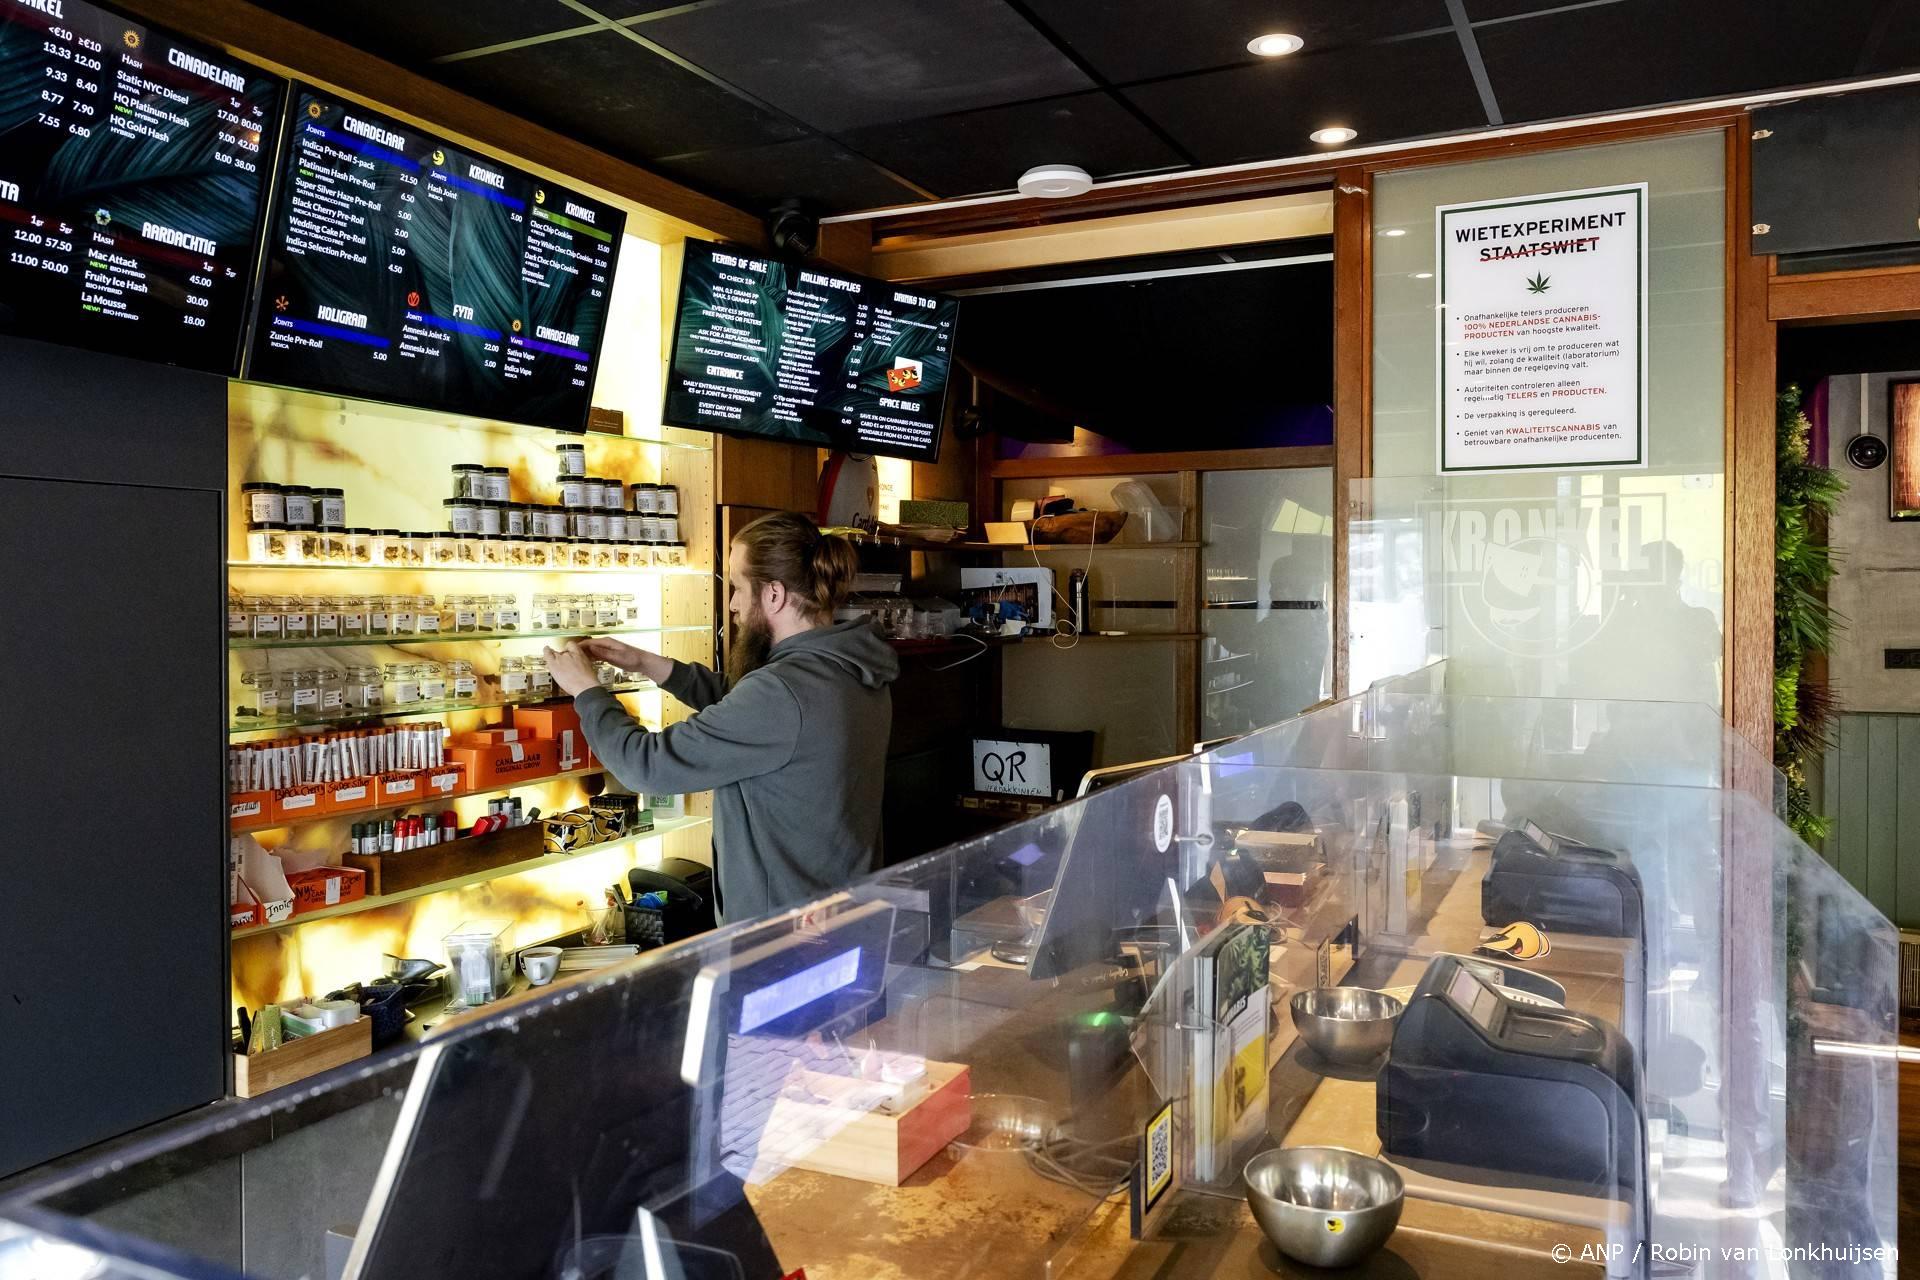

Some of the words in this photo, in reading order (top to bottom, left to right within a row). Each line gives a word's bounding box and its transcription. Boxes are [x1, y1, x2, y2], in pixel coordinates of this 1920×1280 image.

[43, 42, 71, 59] 13.33
[74, 54, 101, 70] 12.00
[46, 67, 67, 82] 9.33
[76, 79, 97, 93] 8.40
[168, 48, 245, 93] CANADELAAR
[42, 90, 64, 104] 8.77
[73, 101, 94, 115] 7.90
[117, 70, 142, 87] Static
[143, 80, 162, 94] NYC
[163, 88, 189, 105] Diesel
[217, 109, 239, 125] 17.00
[241, 118, 262, 133] 80.00
[38, 113, 60, 128] 7.55
[69, 124, 90, 138] 6.80
[113, 92, 129, 104] HQ
[130, 99, 168, 119] Platinum
[169, 114, 189, 128] Hash
[218, 131, 235, 145] 9.00
[238, 139, 259, 153] 42.00
[343, 115, 405, 152] CANADELAAR
[110, 115, 126, 127] HQ
[127, 120, 147, 134] Gold
[148, 128, 170, 143] Hash
[215, 152, 232, 165] 8.00
[234, 158, 256, 173] 38.00
[302, 138, 324, 153] Indica
[324, 146, 352, 162] Pre-Roll
[353, 156, 375, 171] 5-pack
[400, 173, 418, 186] 21.50
[299, 158, 330, 175] Platinum
[331, 168, 348, 182] Hash
[349, 175, 376, 190] Pre-Roll
[400, 192, 415, 204] 6.50
[469, 164, 504, 189] KRONKEL
[292, 196, 312, 210] Black
[312, 202, 337, 218] Cherry
[337, 210, 365, 226] Pre-Roll
[295, 177, 317, 192] Super
[317, 182, 337, 197] Silver
[337, 191, 354, 204] Haze
[354, 195, 381, 212] Pre-Roll
[398, 210, 412, 221] 5.00
[142, 221, 217, 257] AARDACHTIG
[289, 215, 321, 233] Wedding
[321, 226, 339, 237] Cake
[339, 230, 367, 245] Pre-Roll
[1456, 211, 1626, 243] WIETEXPERIMENT
[14, 229, 42, 245] 12.00
[45, 237, 73, 253] 57.50
[1480, 237, 1600, 261] STAATSWIET
[11, 252, 38, 267] 11.00
[42, 260, 69, 275] 50.00
[286, 234, 308, 248] Indica
[308, 241, 340, 257] Selection
[340, 250, 367, 264] Pre-Roll
[387, 263, 403, 275] 4.50
[88, 248, 108, 261] Mac
[108, 252, 138, 269] Attack
[189, 275, 212, 288] 45.00
[85, 270, 112, 286] Fruity
[112, 277, 126, 288] Ice
[126, 280, 148, 294] Hash
[186, 295, 209, 308] 30.00
[81, 292, 93, 302] La
[93, 295, 127, 310] Mousse
[183, 315, 206, 328] 18.00
[318, 304, 367, 329] HOLIGRAM
[453, 304, 474, 321] FYTA
[1464, 310, 1519, 322] Onafhankelijke
[1520, 308, 1543, 317] telers
[1544, 305, 1590, 318] produceren
[1464, 323, 1487, 331] 100%
[1488, 317, 1551, 329] NEDERLANDSE
[1553, 313, 1601, 324] CANNABIS-
[1464, 330, 1515, 340] PRODUCTEN
[1516, 328, 1531, 336] van
[1532, 326, 1564, 336] hoogste
[1565, 322, 1601, 332] kwaliteit.
[270, 331, 294, 343] Zuncle
[294, 335, 323, 349] Pre-Roll
[373, 351, 388, 362] 5.00
[484, 342, 500, 353] 22.00
[1464, 349, 1480, 358] Elke
[1481, 347, 1508, 356] kweker
[1510, 346, 1517, 354] is
[1518, 345, 1532, 355] vrij
[1533, 345, 1546, 353] om
[1547, 343, 1556, 352] te
[1557, 340, 1603, 353] produceren
[1605, 339, 1620, 348] wat
[1464, 358, 1474, 368] hij
[1489, 356, 1514, 366] zolang
[1516, 355, 1526, 363] de
[1527, 353, 1560, 363] kwaliteit
[1562, 349, 1620, 361] (laboratorium)
[1464, 368, 1483, 376] maar
[1485, 365, 1511, 374] binnen
[1512, 364, 1523, 373] de
[1524, 362, 1570, 373] regelgeving
[1571, 360, 1589, 369] valt.
[1464, 384, 1509, 393] Autoriteiten
[1510, 381, 1556, 391] controleren
[1557, 379, 1581, 388] alleen
[1506, 391, 1538, 400] TELERS
[1540, 390, 1550, 398] en
[1552, 387, 1607, 397] PRODUCTEN.
[1464, 411, 1475, 420] De
[1476, 410, 1518, 420] verpakking
[1519, 409, 1526, 417] is
[1527, 407, 1577, 418] gereguleerd.
[1464, 428, 1489, 437] Geniet
[1490, 428, 1504, 436] van
[1506, 423, 1601, 435] KWALITEITSCANNABIS
[1603, 422, 1618, 430] van
[1464, 436, 1511, 446] betrouwbare
[1513, 434, 1568, 446] onafhankelijke
[1570, 432, 1622, 443] producenten.
[1429, 504, 1649, 572] KRONKEL
[982, 750, 1026, 786] QR
